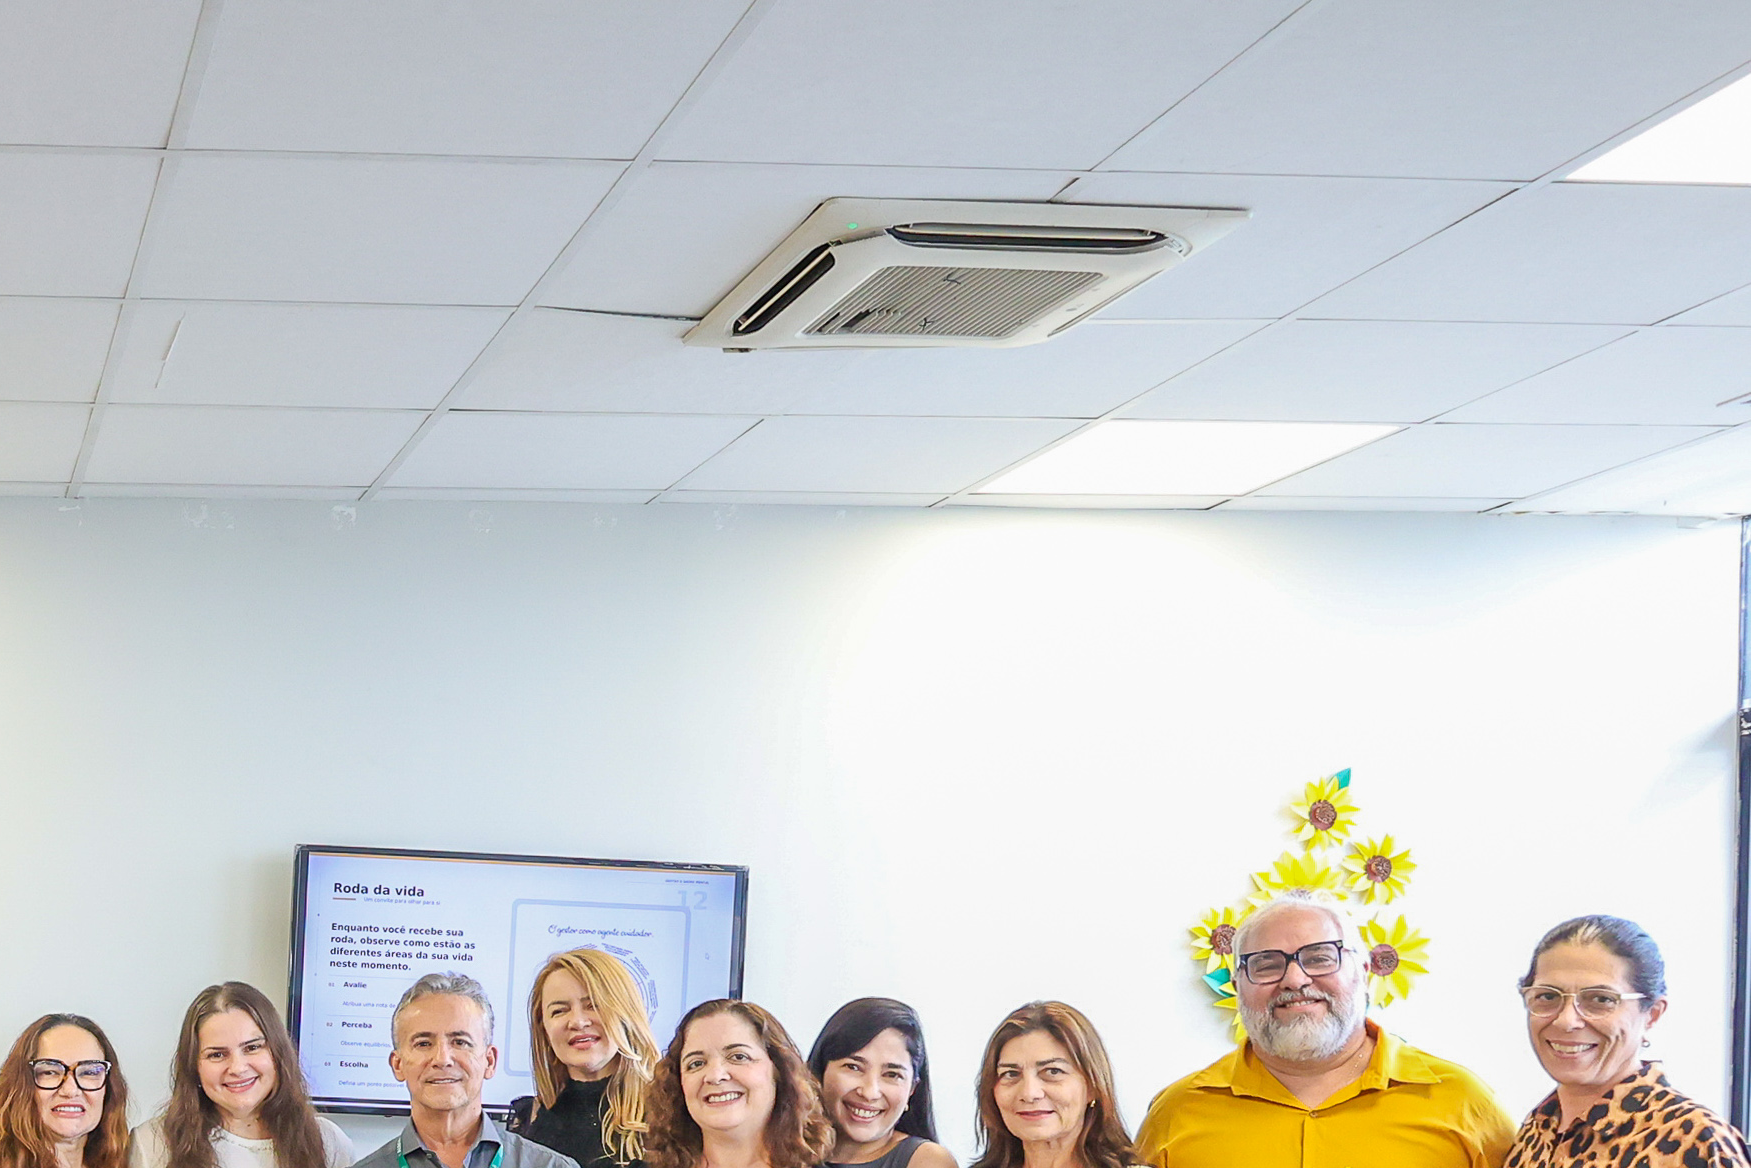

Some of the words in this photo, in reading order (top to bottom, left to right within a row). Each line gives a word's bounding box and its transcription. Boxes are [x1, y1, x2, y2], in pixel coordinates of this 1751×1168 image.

[334, 883, 368, 894] Roda
[374, 884, 390, 895] da
[395, 886, 425, 897] vida
[678, 890, 707, 910] 12
[331, 923, 379, 933] Enquanto
[383, 925, 406, 934] você
[409, 927, 443, 936] recebe
[446, 929, 464, 937] sua
[598, 928, 619, 939] agente
[331, 935, 356, 945] roda,
[360, 937, 400, 946] observe
[433, 940, 461, 949] estão
[330, 947, 382, 957] diferentes
[385, 949, 413, 959] áreas
[415, 951, 428, 959] da
[452, 952, 474, 961] vida
[329, 960, 358, 968] neste
[361, 961, 411, 971] momento.
[339, 1060, 368, 1068] Escolha
